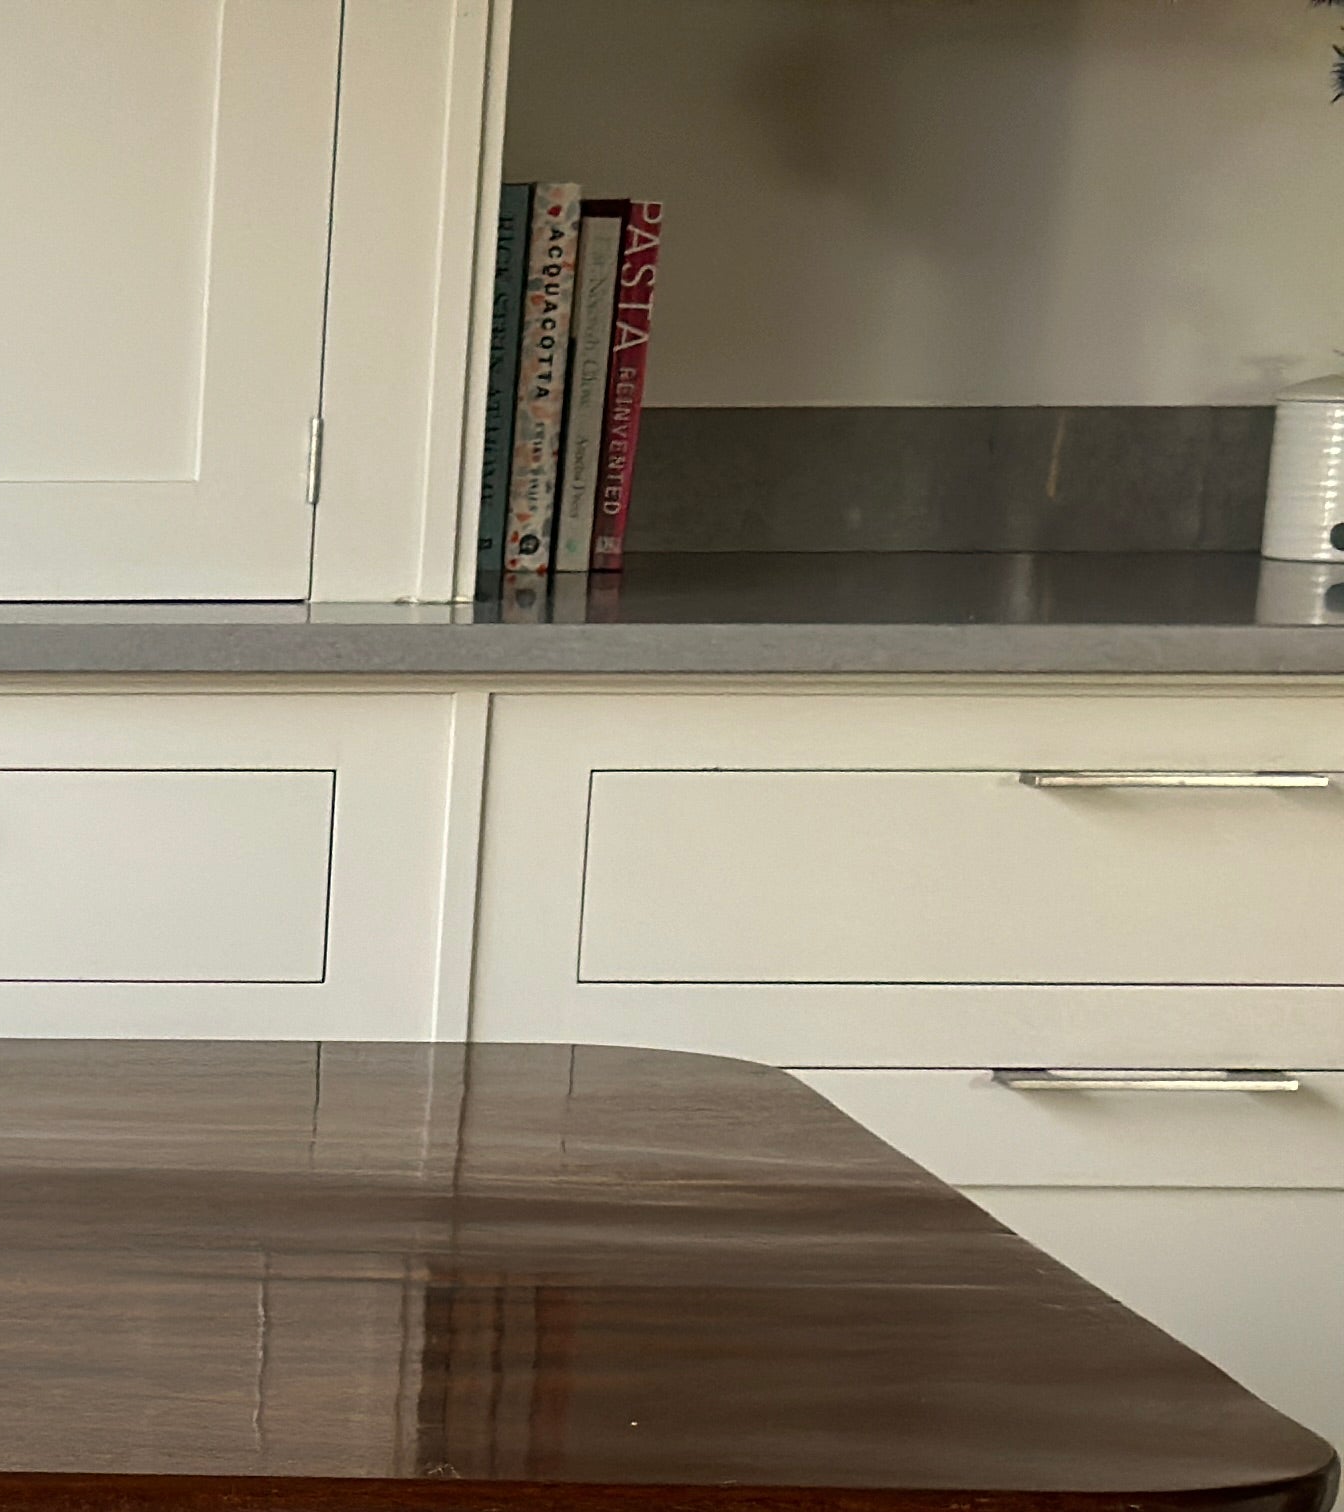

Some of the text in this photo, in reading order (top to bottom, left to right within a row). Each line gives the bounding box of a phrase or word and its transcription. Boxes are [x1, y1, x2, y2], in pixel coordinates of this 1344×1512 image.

[535, 227, 565, 399] ACQUACOTTA
[603, 199, 663, 515] PASTA REINVENTED
